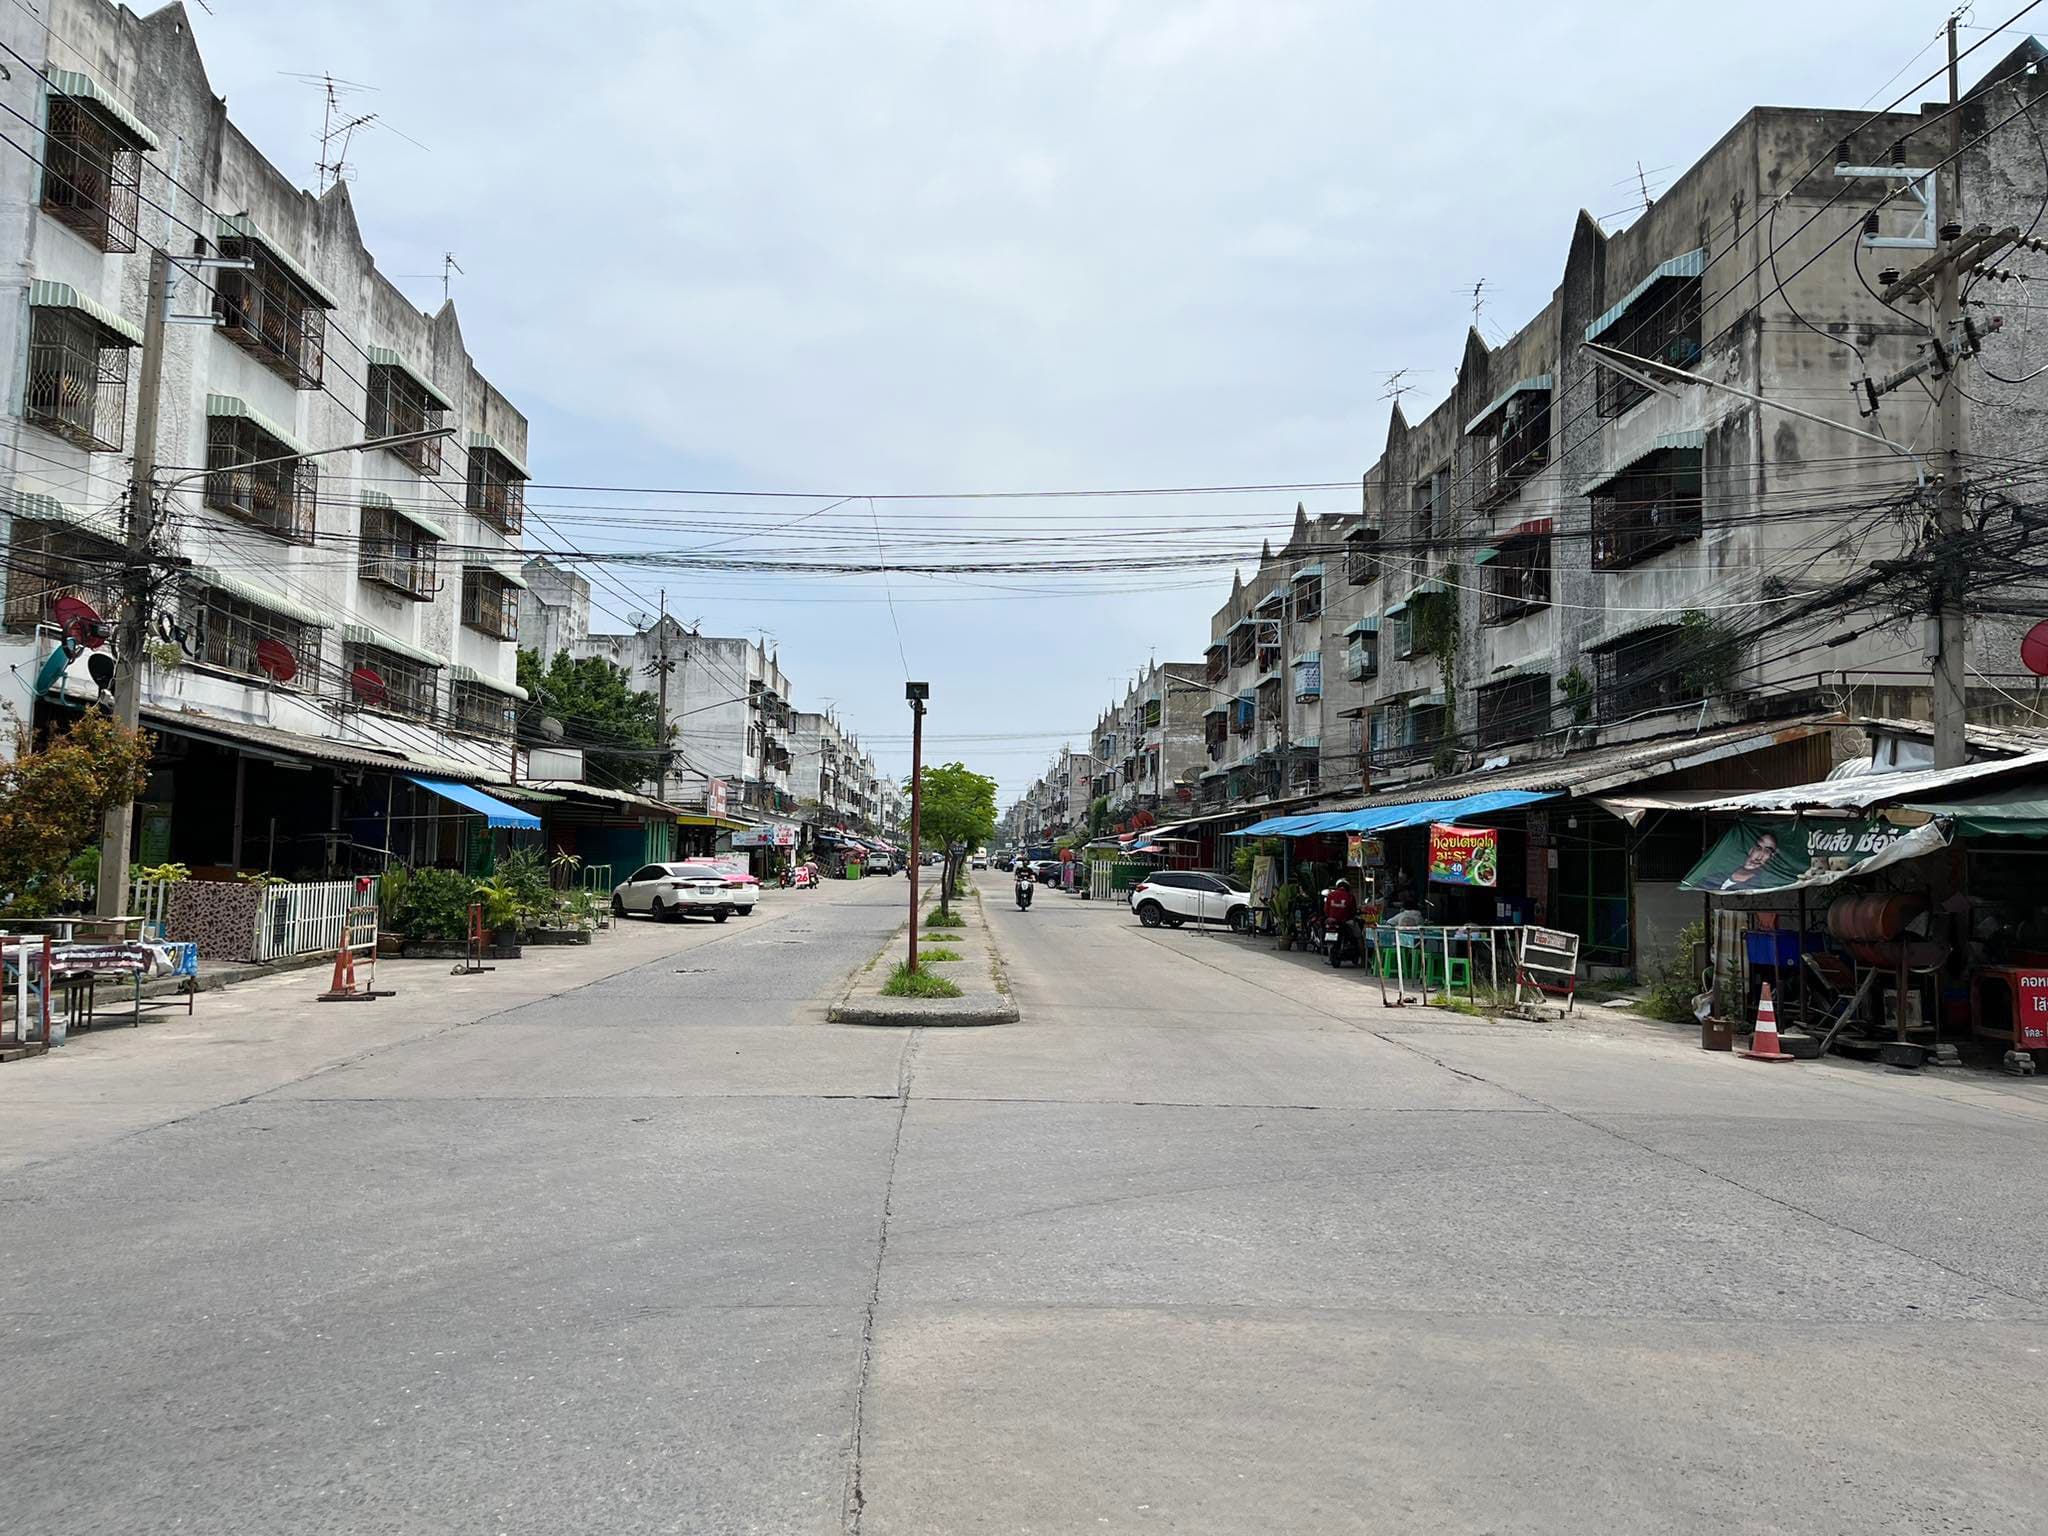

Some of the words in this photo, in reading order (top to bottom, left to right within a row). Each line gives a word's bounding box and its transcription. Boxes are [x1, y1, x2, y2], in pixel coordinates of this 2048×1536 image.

[1807, 827, 1853, 856] ปูนเสือ
[1451, 863, 1462, 873] 40
[2020, 976, 2048, 988] คอห
